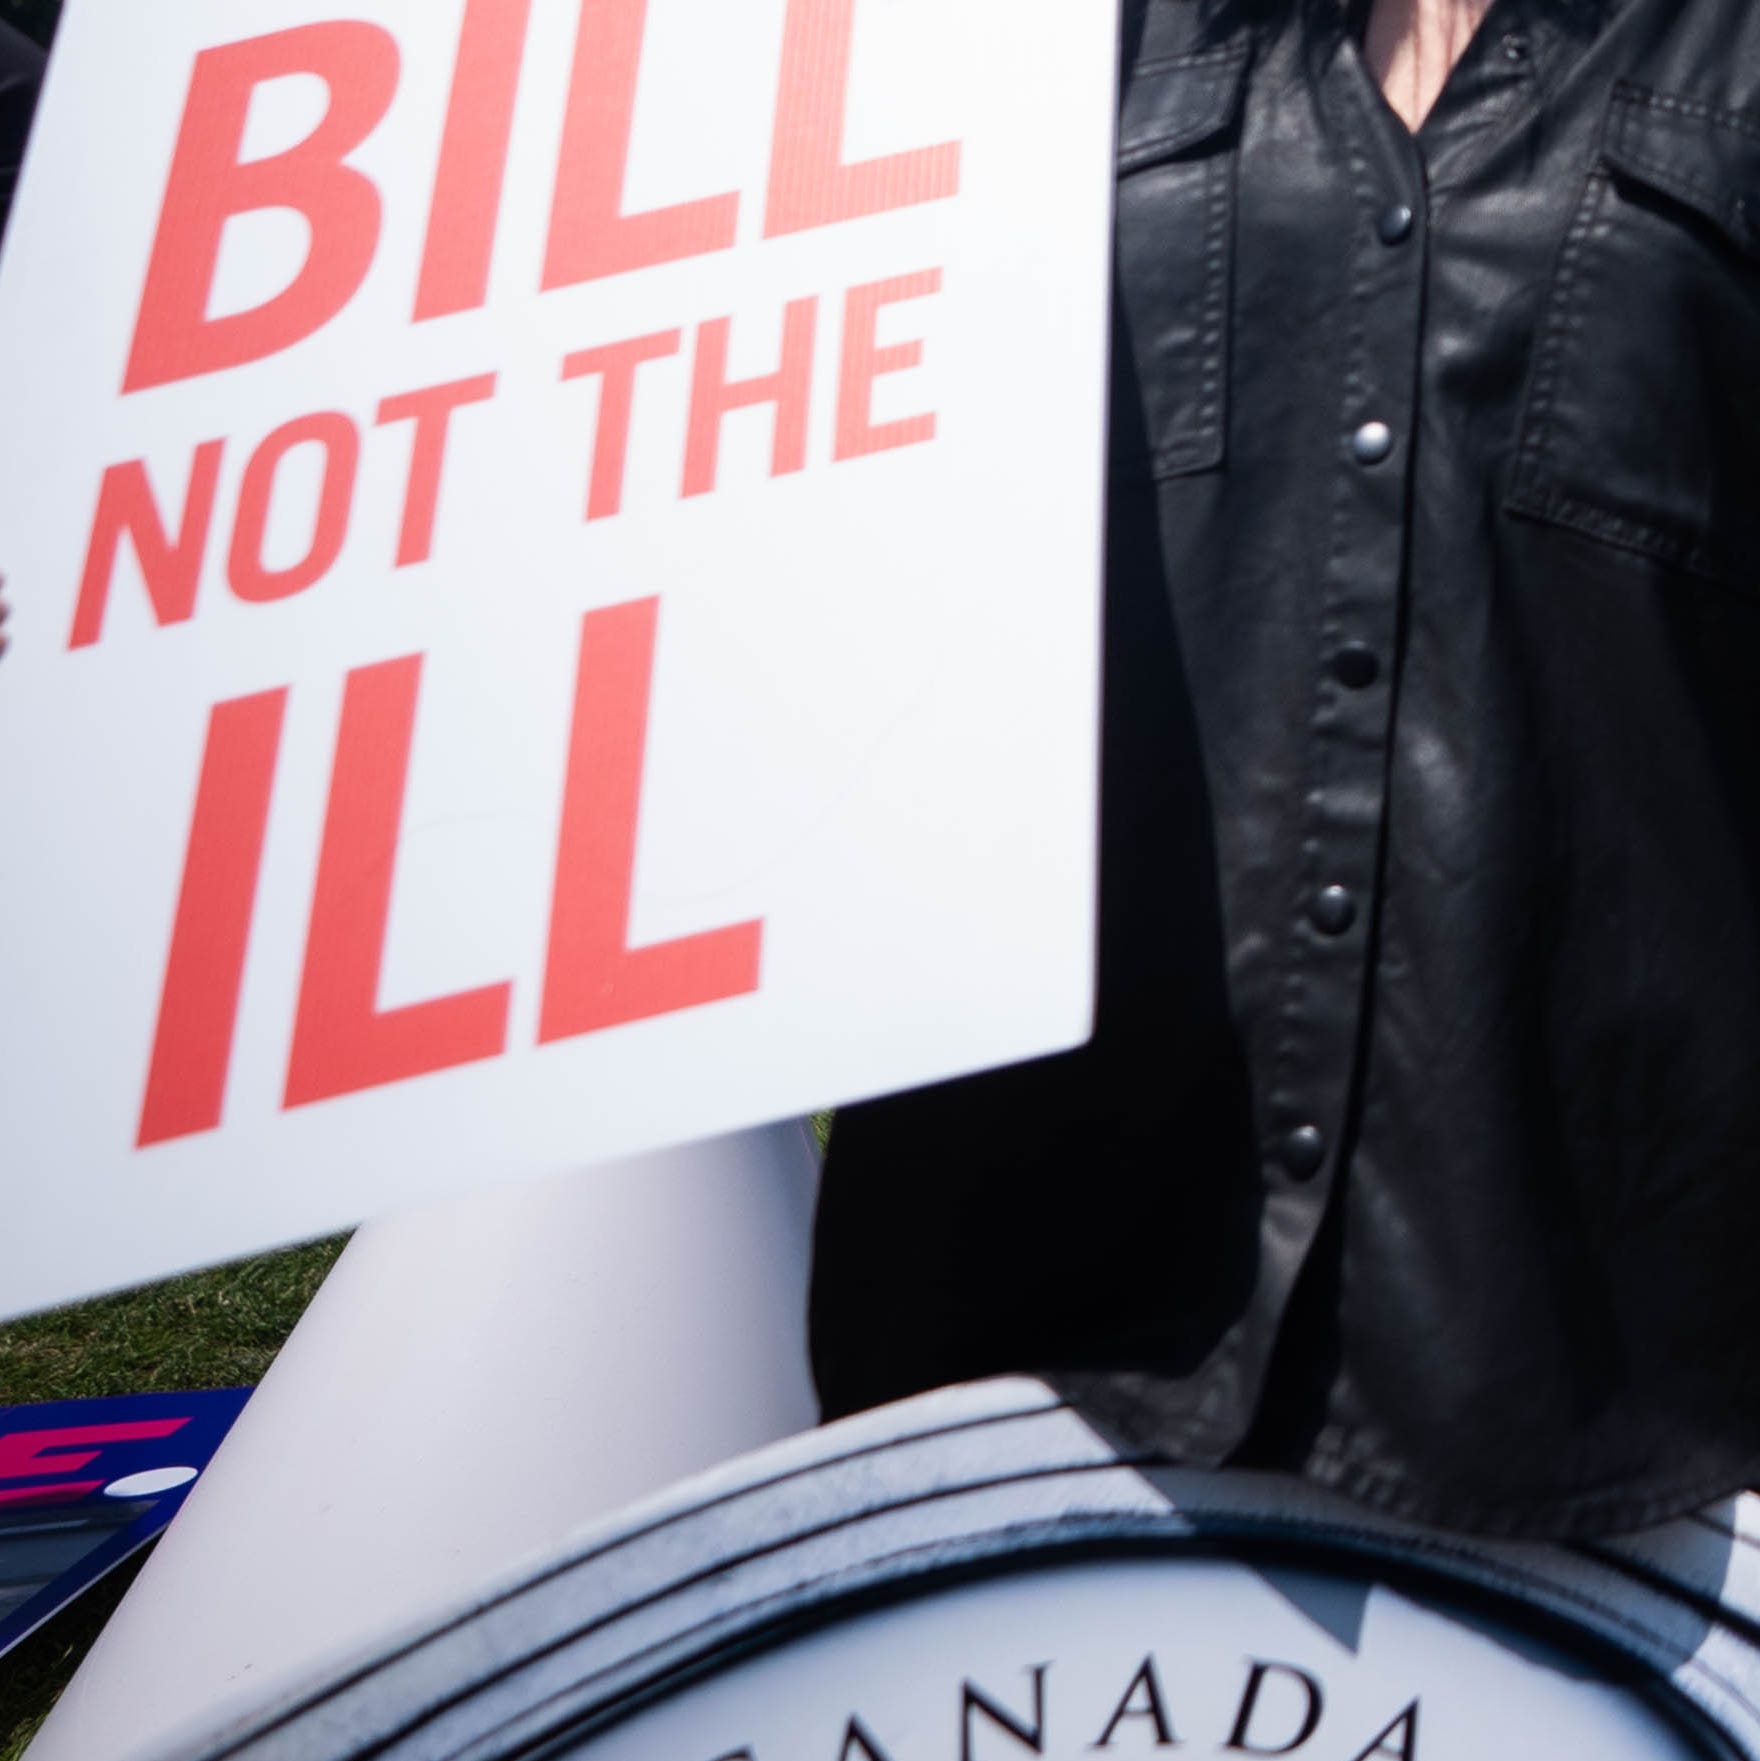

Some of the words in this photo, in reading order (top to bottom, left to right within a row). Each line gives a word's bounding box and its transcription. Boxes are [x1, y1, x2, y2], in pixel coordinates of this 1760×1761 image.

[67, 371, 497, 651] NOT
[559, 266, 943, 523] THE
[135, 595, 764, 1150] ILL
